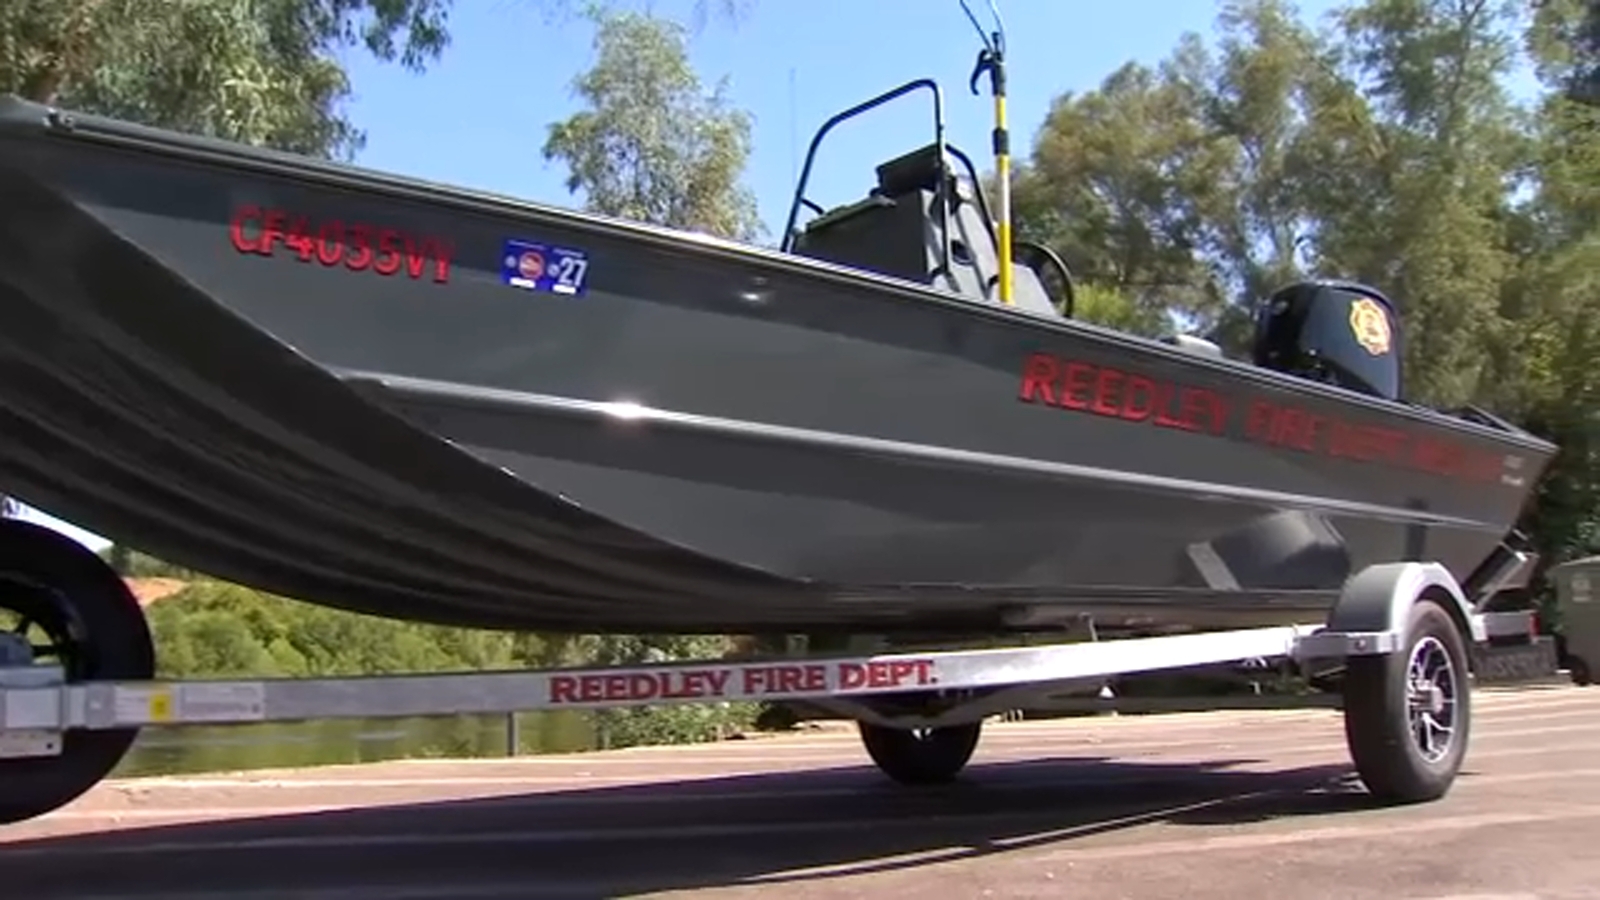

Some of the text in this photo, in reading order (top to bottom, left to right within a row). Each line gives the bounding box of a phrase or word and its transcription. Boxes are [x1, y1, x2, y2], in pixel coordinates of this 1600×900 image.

[559, 257, 587, 287] 27
[1020, 352, 1230, 436] REEDLEY
[550, 659, 938, 703] REEDLEY FIRE DEPT.
